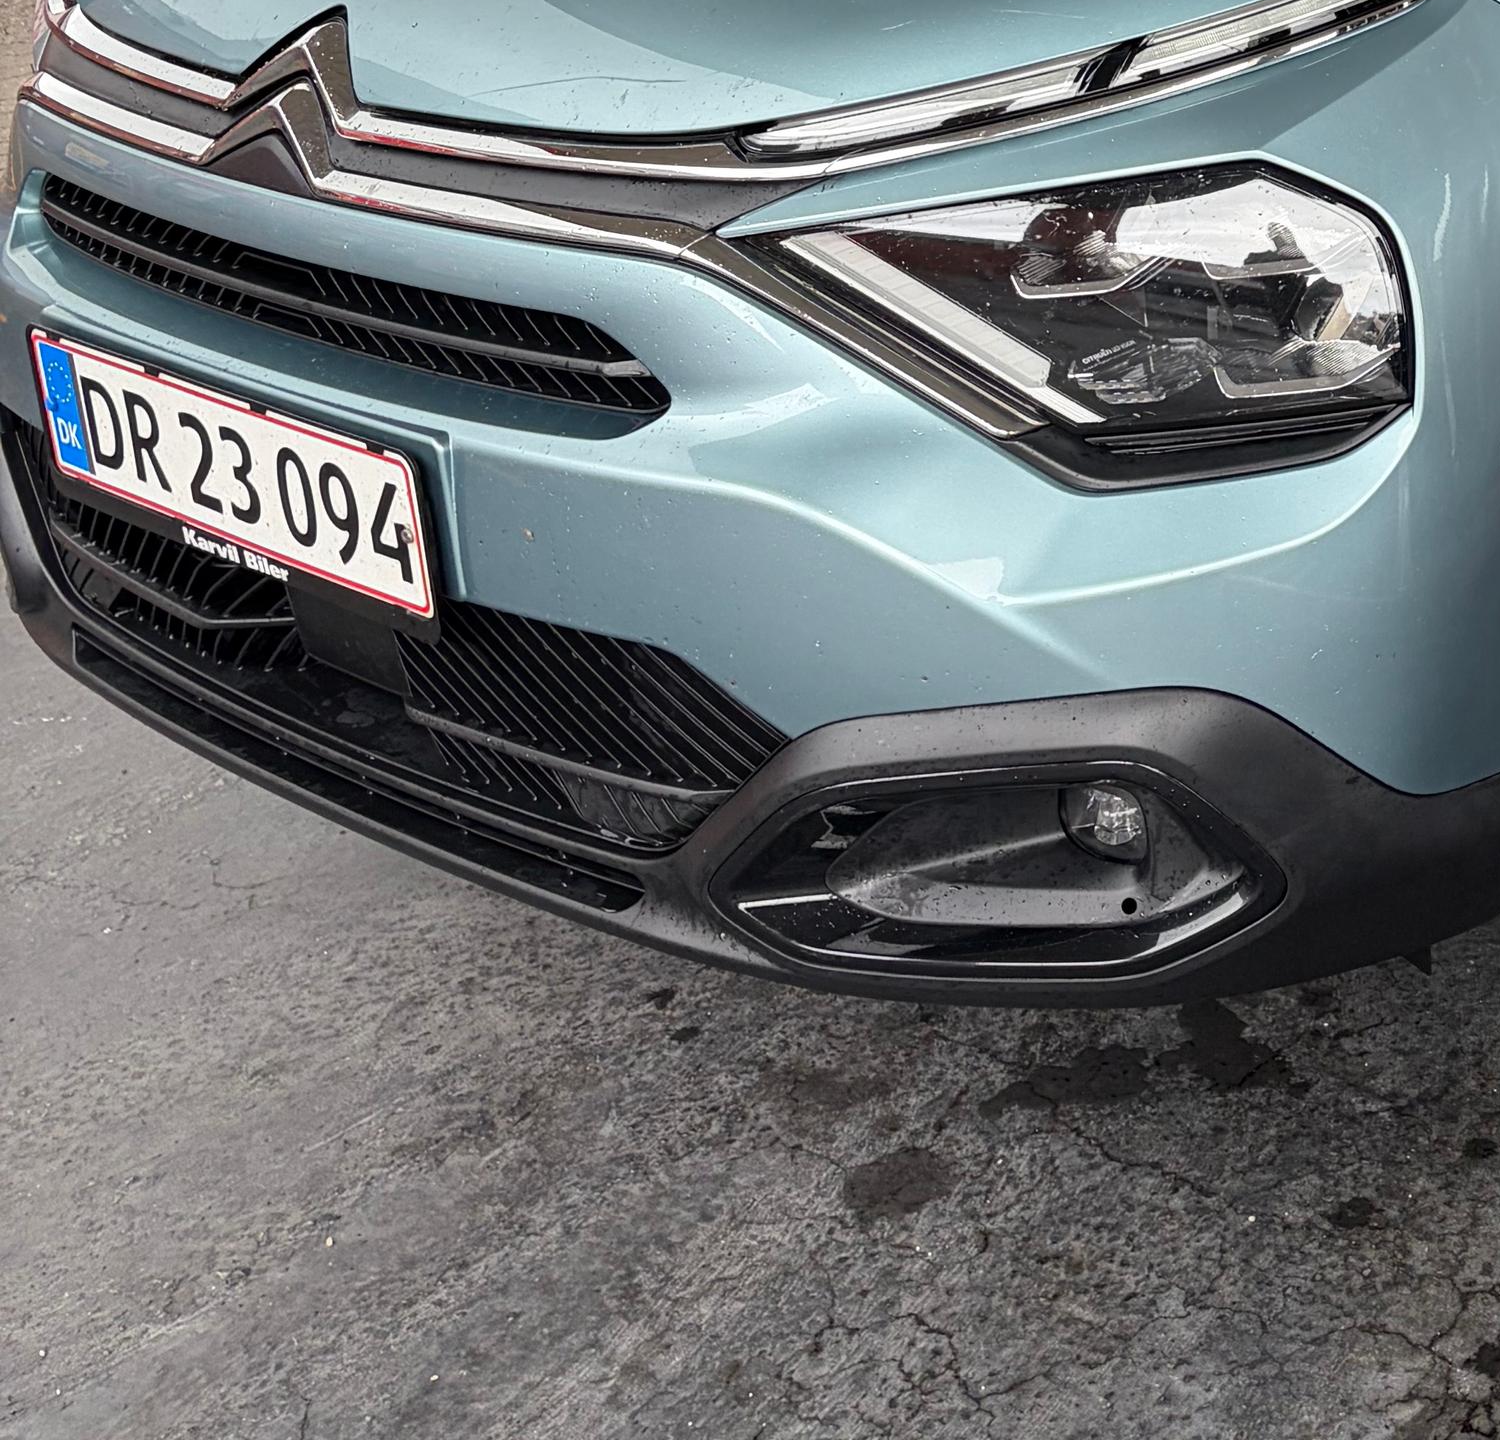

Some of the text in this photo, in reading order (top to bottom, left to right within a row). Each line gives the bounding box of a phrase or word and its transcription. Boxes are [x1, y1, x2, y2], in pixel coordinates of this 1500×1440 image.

[56, 416, 82, 450] DK
[80, 375, 414, 584] DR 23 094
[182, 525, 289, 582] Karvil Biler
